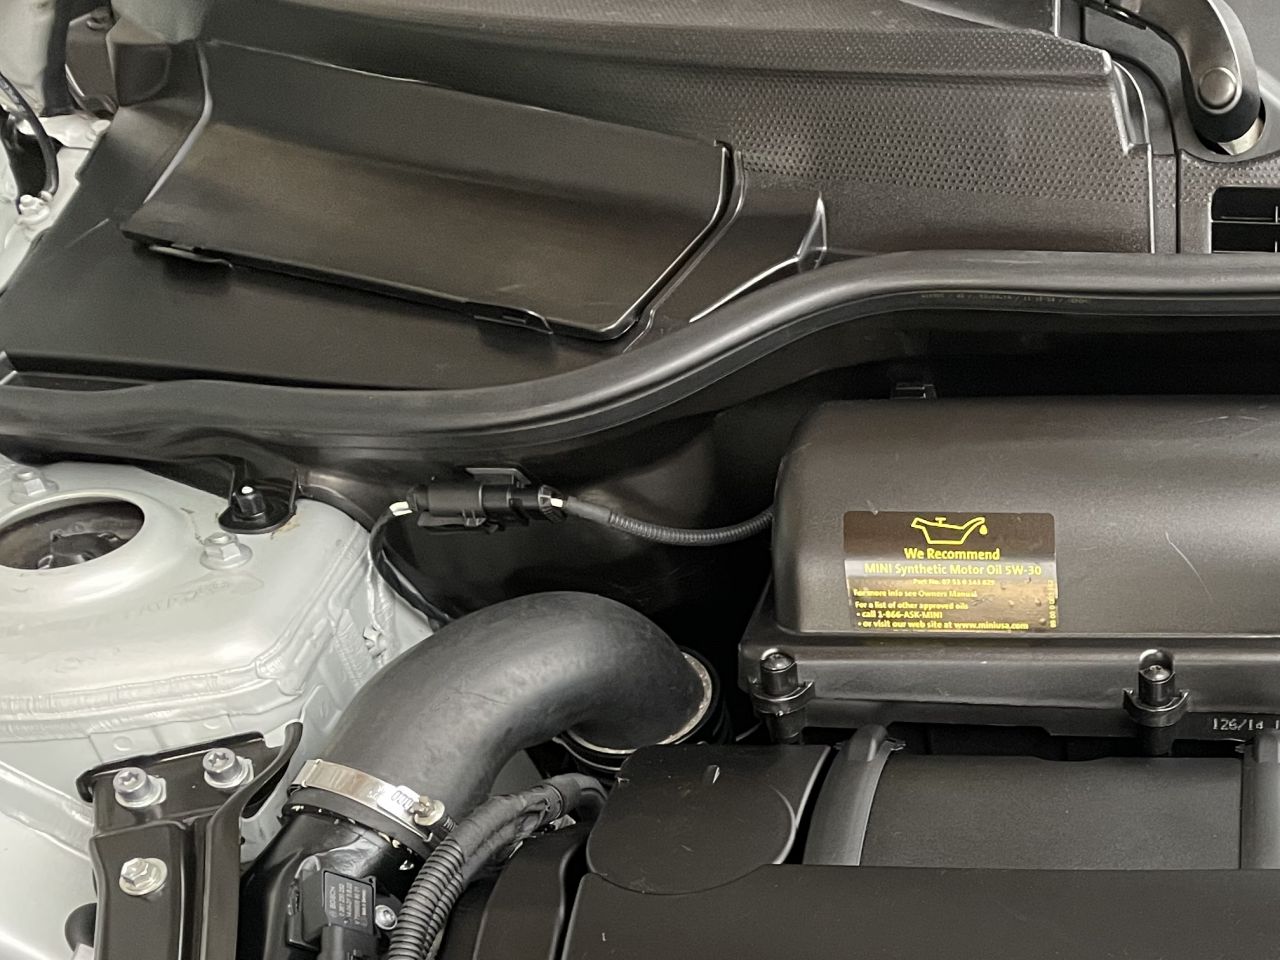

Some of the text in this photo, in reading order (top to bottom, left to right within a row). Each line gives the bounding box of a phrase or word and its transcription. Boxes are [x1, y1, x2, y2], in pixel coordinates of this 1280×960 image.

[903, 548, 1000, 560] We Recommend
[864, 563, 1042, 577] MINI Synthetic Motor Oil 5W-30
[919, 602, 954, 611] approved
[908, 620, 926, 628] web
[954, 621, 1029, 630] www.miniusa.com
